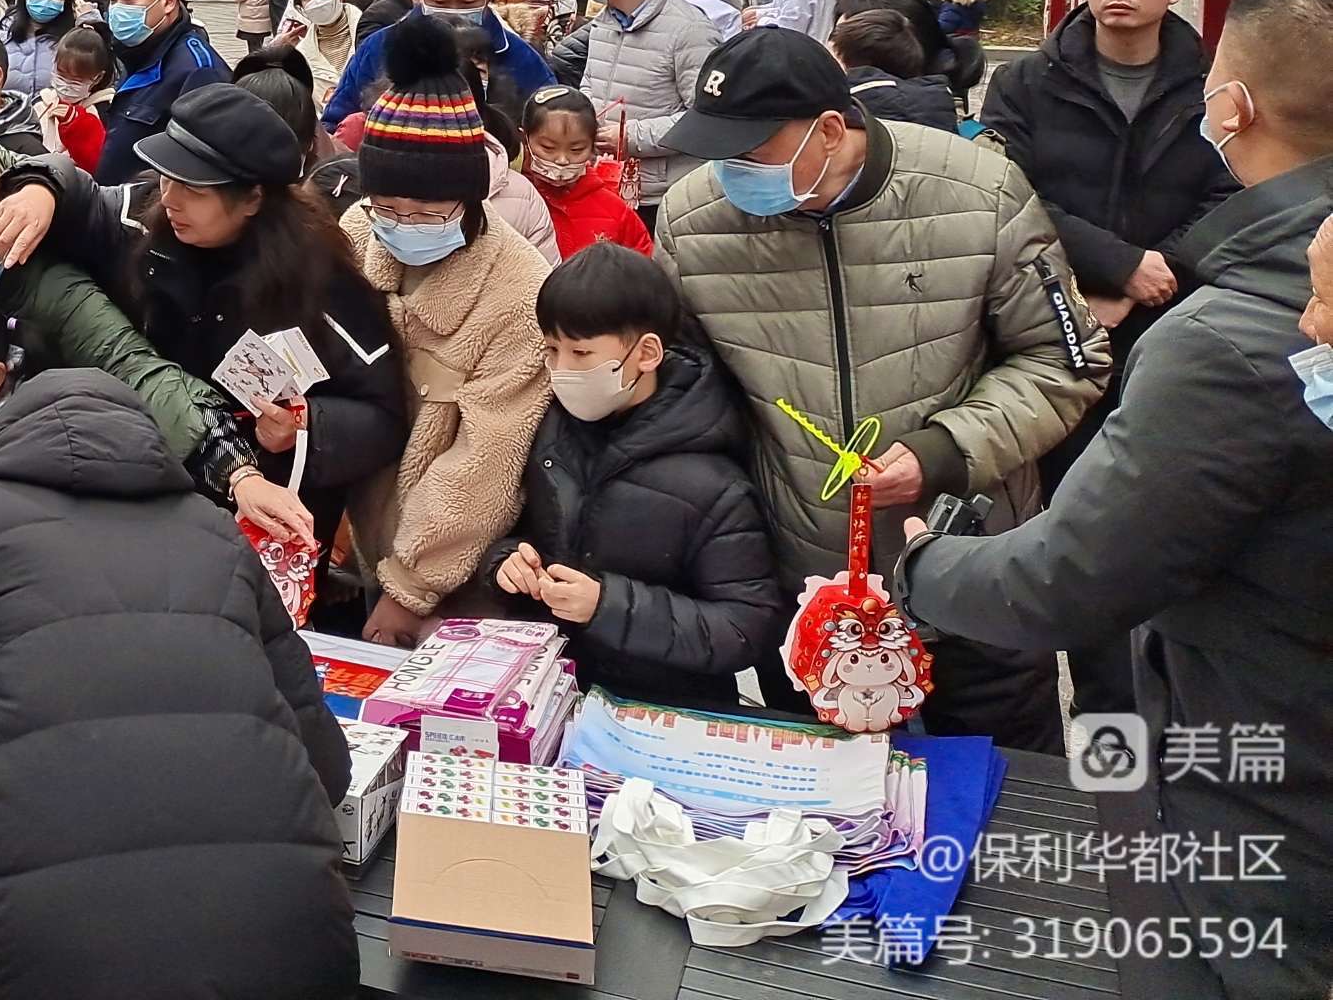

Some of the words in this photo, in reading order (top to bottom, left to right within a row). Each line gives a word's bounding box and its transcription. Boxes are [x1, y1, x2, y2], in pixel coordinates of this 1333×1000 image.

[703, 69, 726, 97] R
[1053, 292, 1085, 369] QIAODAN
[383, 643, 445, 691] HONGLE
